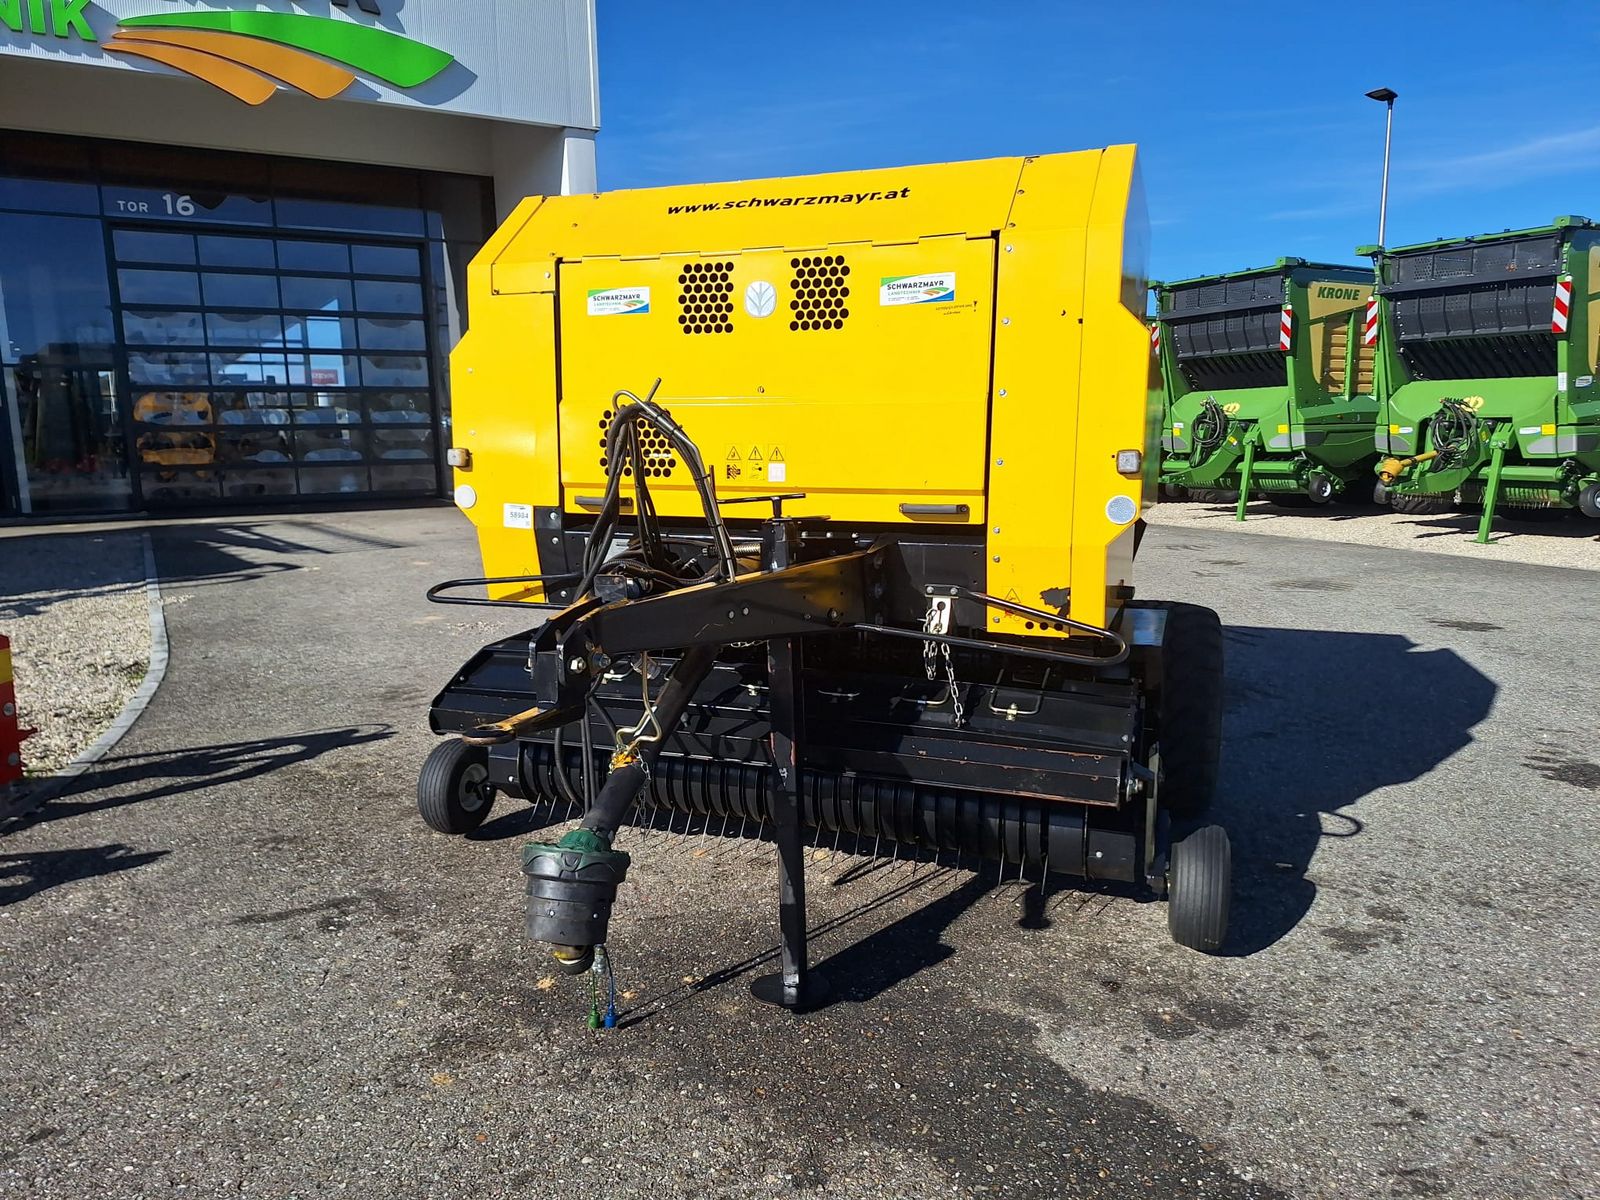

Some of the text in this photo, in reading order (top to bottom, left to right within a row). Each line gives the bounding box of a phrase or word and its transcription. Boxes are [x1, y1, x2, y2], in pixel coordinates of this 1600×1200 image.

[117, 194, 195, 216] TOR 16
[667, 187, 911, 215] www.schwarzmayr.at
[887, 280, 944, 290] SCHWARZMAYR
[1317, 286, 1360, 300] KRONE
